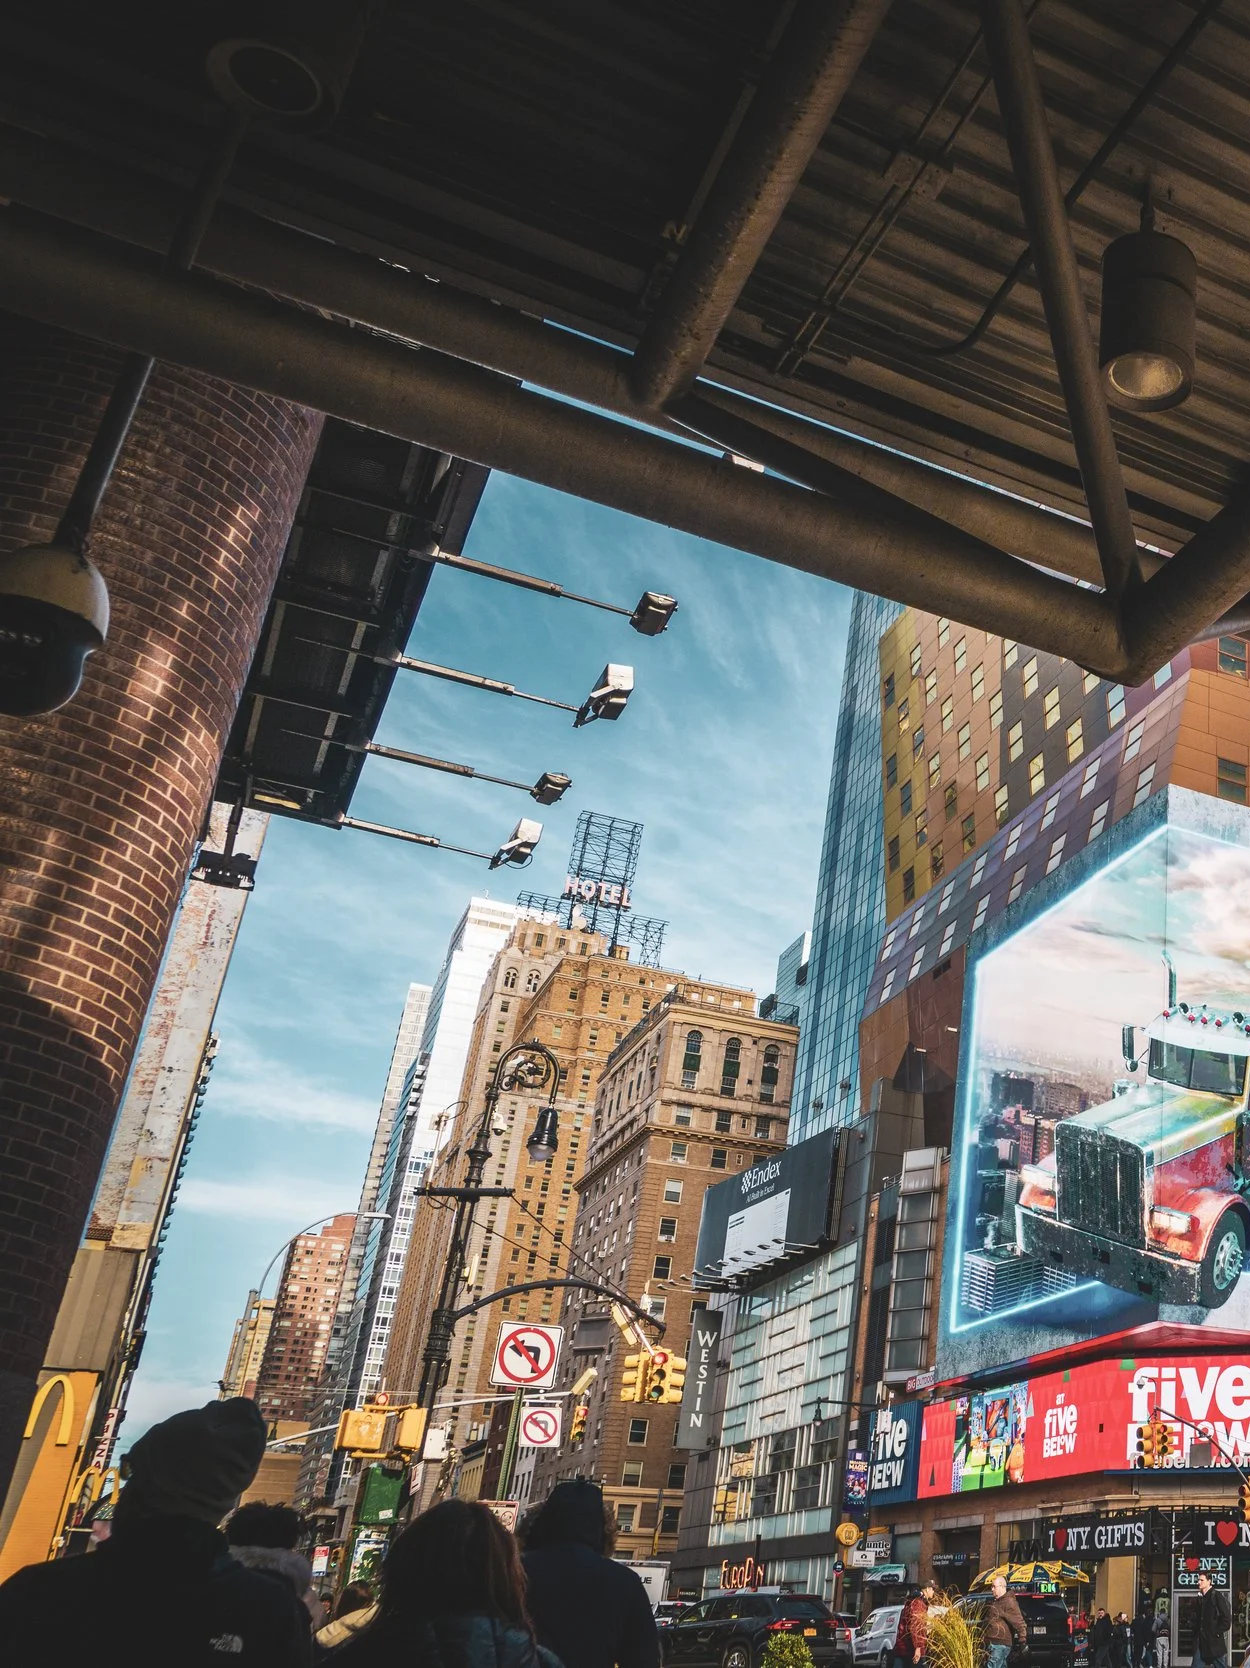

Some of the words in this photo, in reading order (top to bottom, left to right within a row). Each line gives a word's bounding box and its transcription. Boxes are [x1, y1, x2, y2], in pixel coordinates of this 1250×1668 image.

[565, 874, 632, 907] HOTEL
[751, 1161, 781, 1188] Endex
[689, 1330, 718, 1427] WESTIN
[907, 1378, 915, 1389] BIG
[917, 1374, 934, 1386] OUTDOO
[1044, 1404, 1077, 1437] five
[1043, 1433, 1077, 1458] BELOW
[1048, 1530, 1055, 1552] I
[1094, 1522, 1145, 1549] GIFTS
[1204, 1521, 1216, 1546] I
[1178, 1558, 1187, 1571] I
[1200, 1558, 1227, 1571] NY
[1178, 1573, 1226, 1586] GITS
